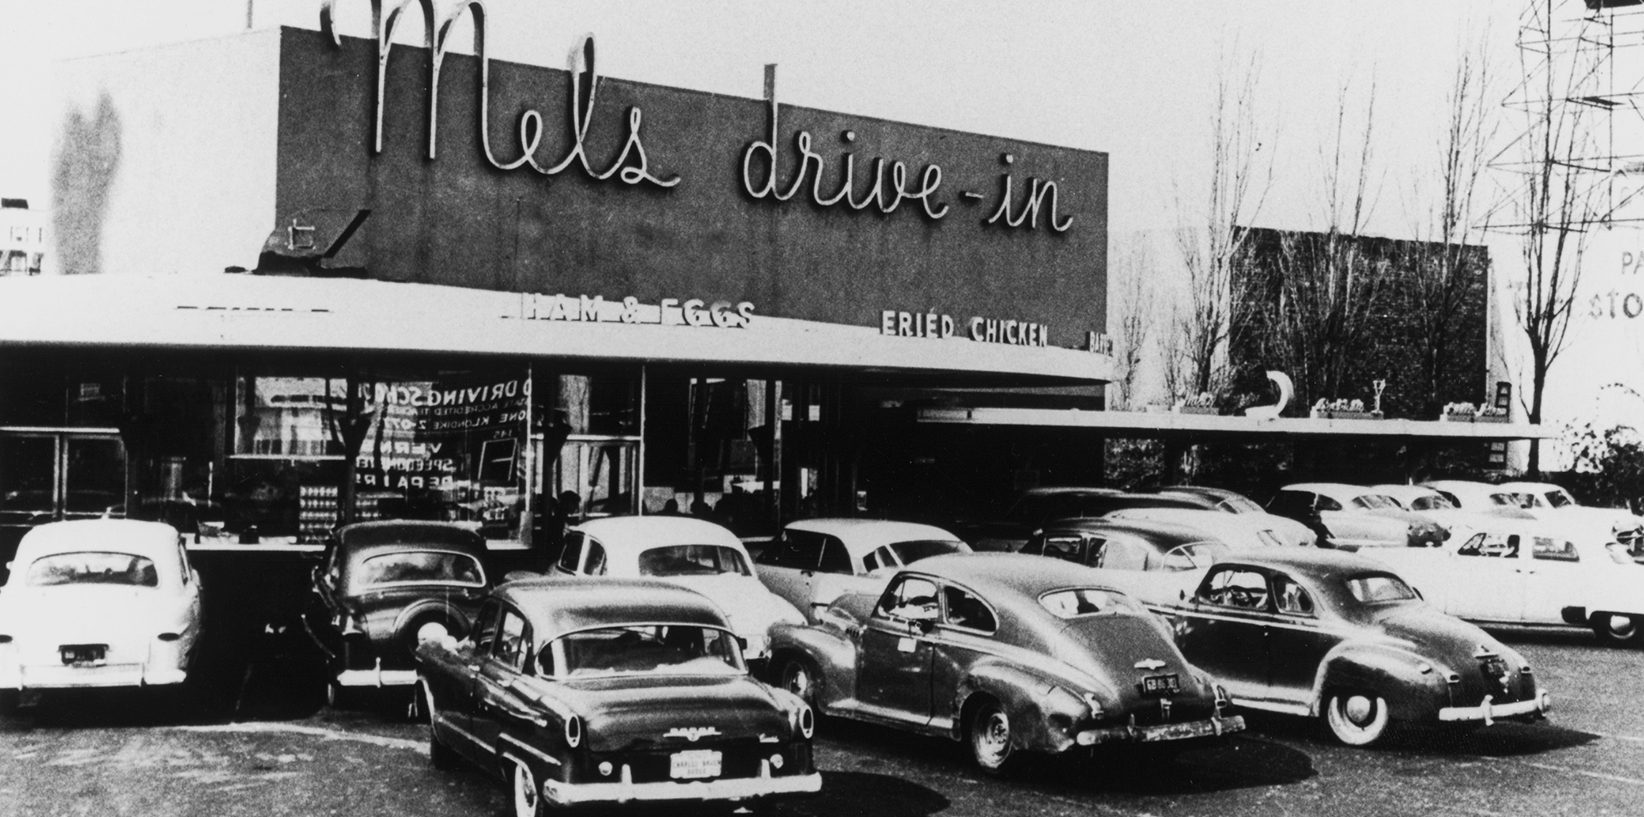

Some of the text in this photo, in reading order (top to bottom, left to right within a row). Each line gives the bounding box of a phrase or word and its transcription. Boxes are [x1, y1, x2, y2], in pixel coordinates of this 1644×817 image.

[320, 0, 681, 188] Mels
[521, 292, 755, 328] HAM & EGGS
[971, 316, 1048, 347] CHICKEN
